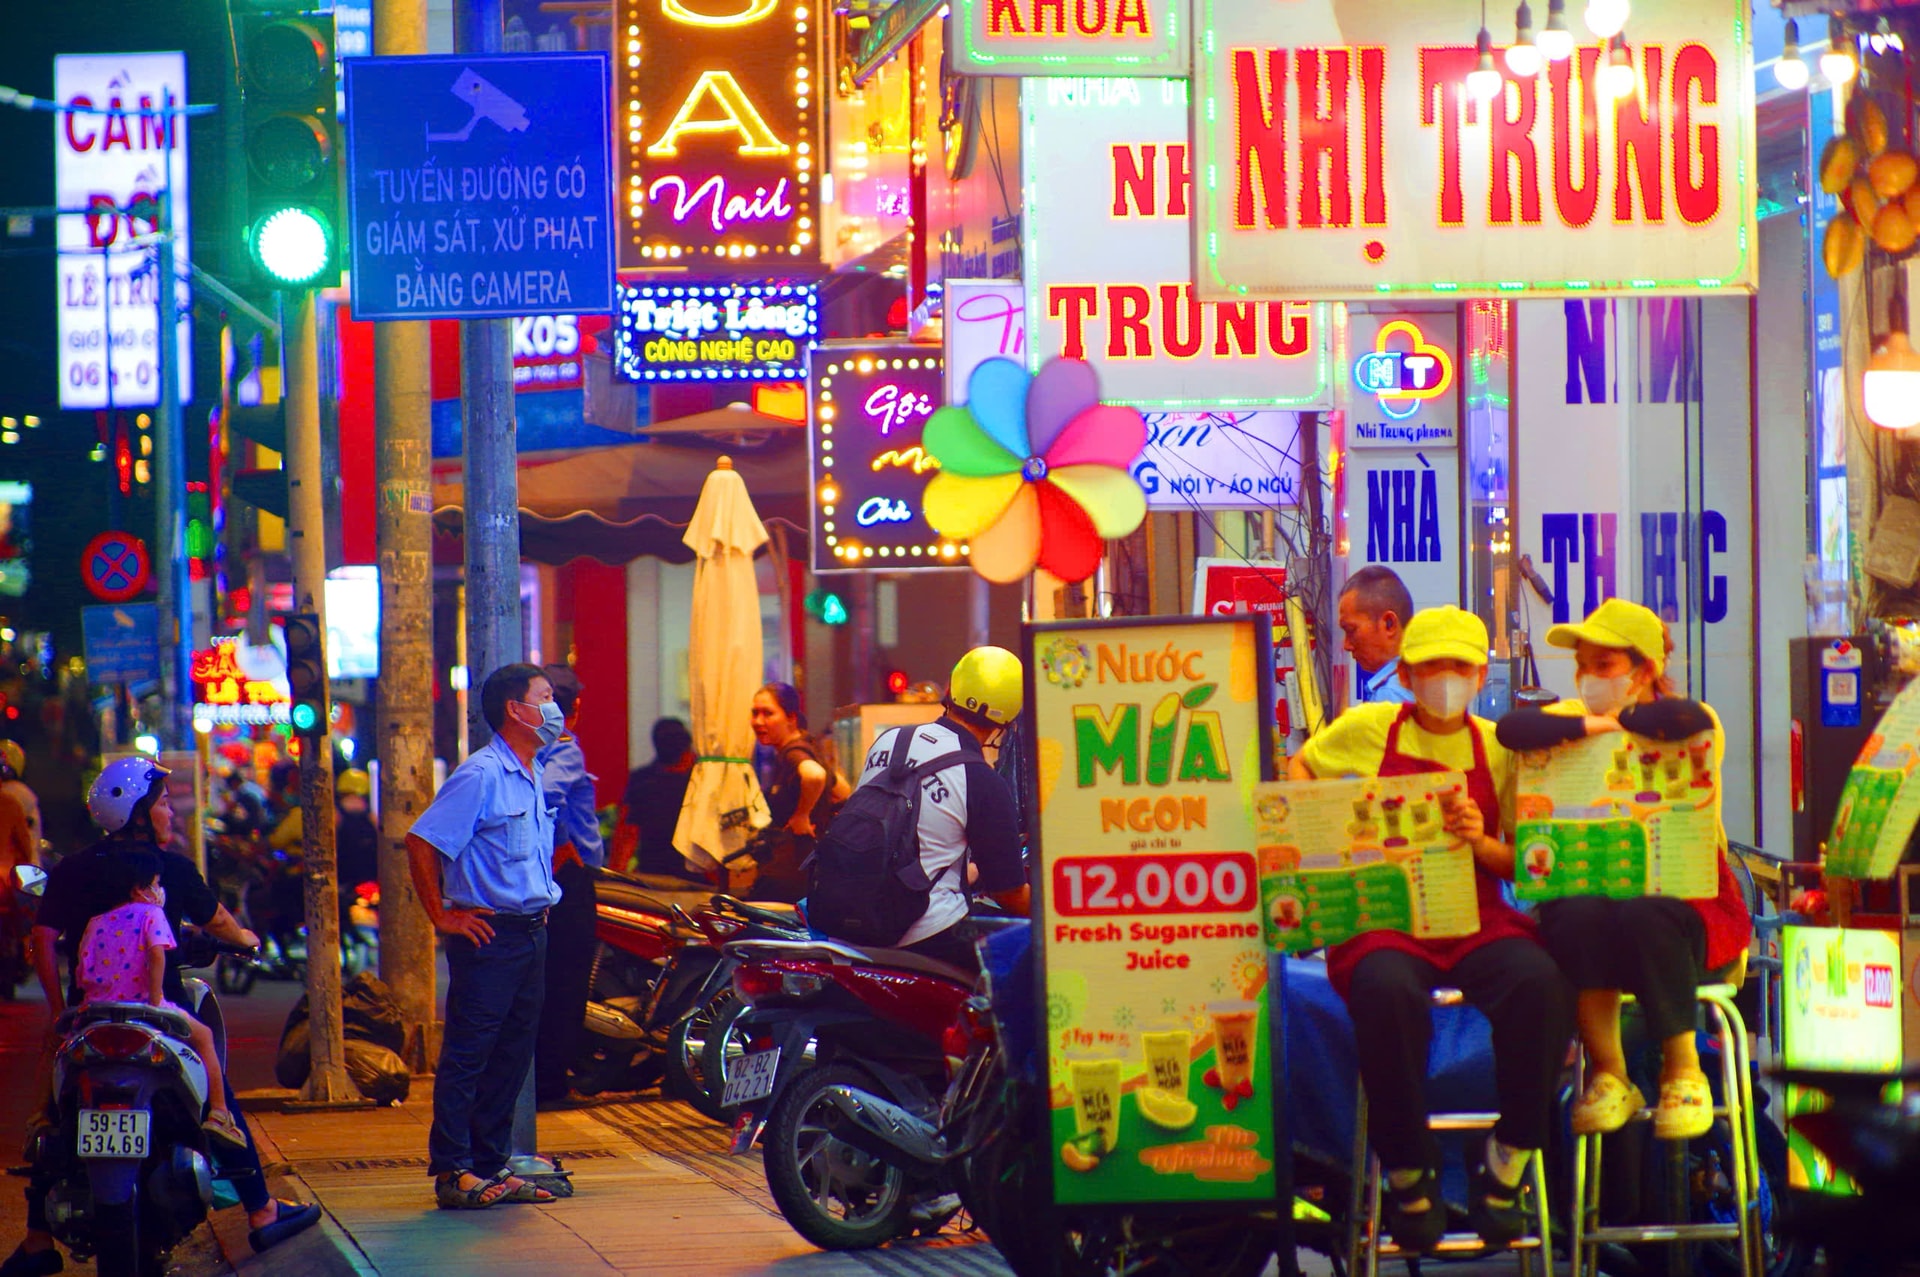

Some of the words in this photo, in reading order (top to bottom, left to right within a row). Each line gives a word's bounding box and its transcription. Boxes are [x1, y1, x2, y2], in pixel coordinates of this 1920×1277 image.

[1231, 45, 1388, 263] NHỊ
[1418, 42, 1721, 229] TRUNG
[374, 155, 454, 203] TUYẾN
[462, 158, 548, 202] ĐƯỜNG
[555, 155, 586, 199] CÓ
[649, 175, 791, 231] Nail
[1110, 142, 1191, 220] NH
[366, 211, 426, 256] GIÁM
[493, 205, 527, 252] XỬ
[534, 215, 598, 258] PHẠT
[396, 256, 463, 308] BẰNG
[471, 270, 572, 306] CAMERA
[1046, 282, 1312, 360] TRUNG
[644, 337, 698, 362] CÔNG
[700, 336, 754, 364] NGHỆ
[756, 339, 796, 361] CAO
[1205, 478, 1215, 493] Y
[1228, 471, 1253, 494] ÁO
[1366, 452, 1442, 562] NHÀ
[1095, 641, 1206, 684] Nước
[1100, 795, 1208, 834] NGON
[1062, 861, 1248, 910] 12.000
[1055, 923, 1123, 943] Fresh
[1129, 919, 1260, 945] Sugarcane
[1126, 950, 1191, 972] Juice
[82, 1134, 145, 1154] 534.69
[89, 1113, 136, 1133] 59-E1
